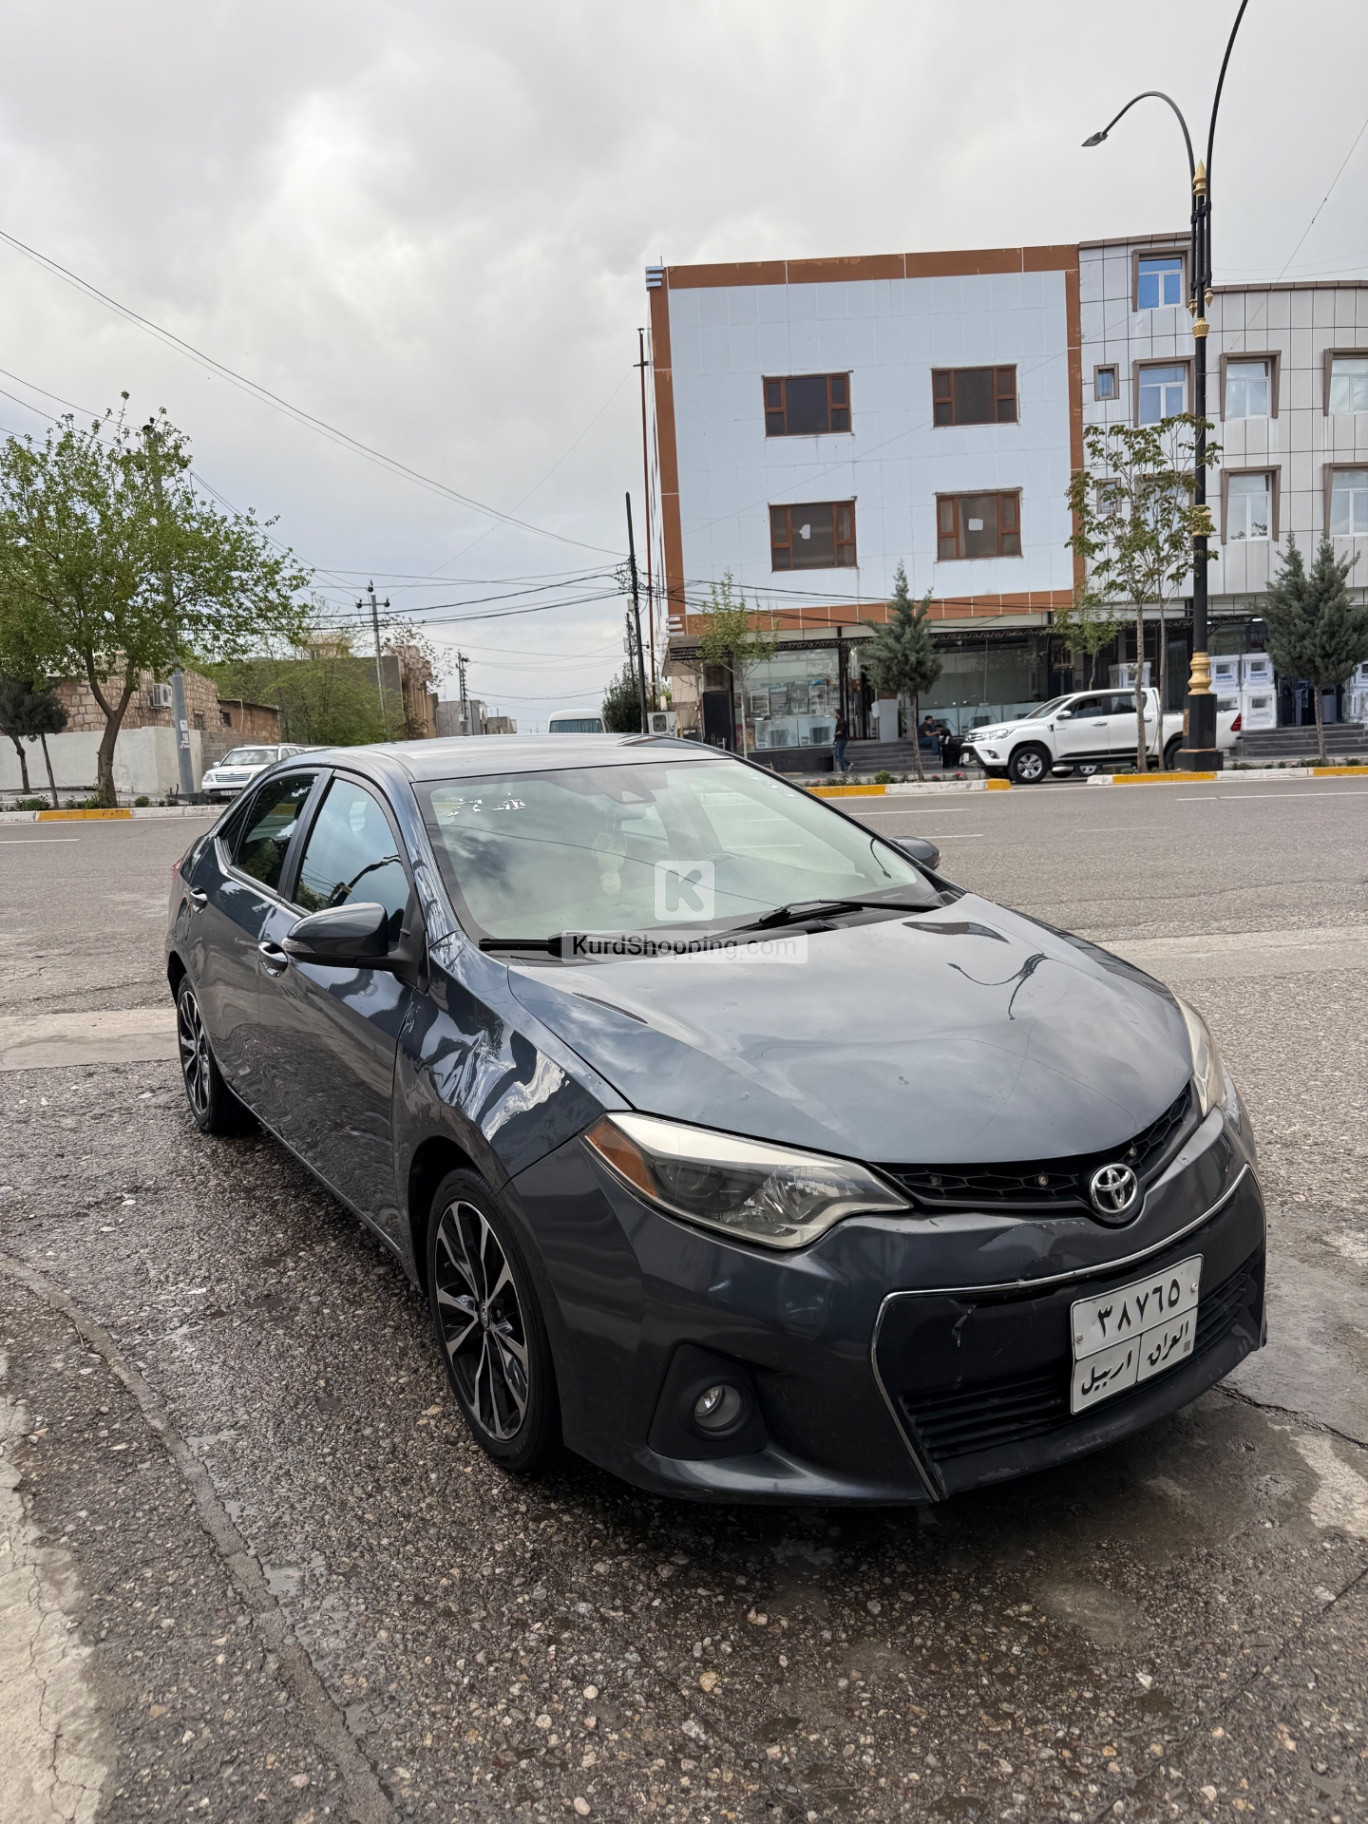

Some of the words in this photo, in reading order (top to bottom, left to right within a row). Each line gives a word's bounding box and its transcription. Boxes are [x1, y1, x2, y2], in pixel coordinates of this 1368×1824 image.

[1097, 1278, 1181, 1338] ٣٨٧٦٥
[1147, 1320, 1190, 1366] العراق
[1081, 1349, 1133, 1395] اربيل
